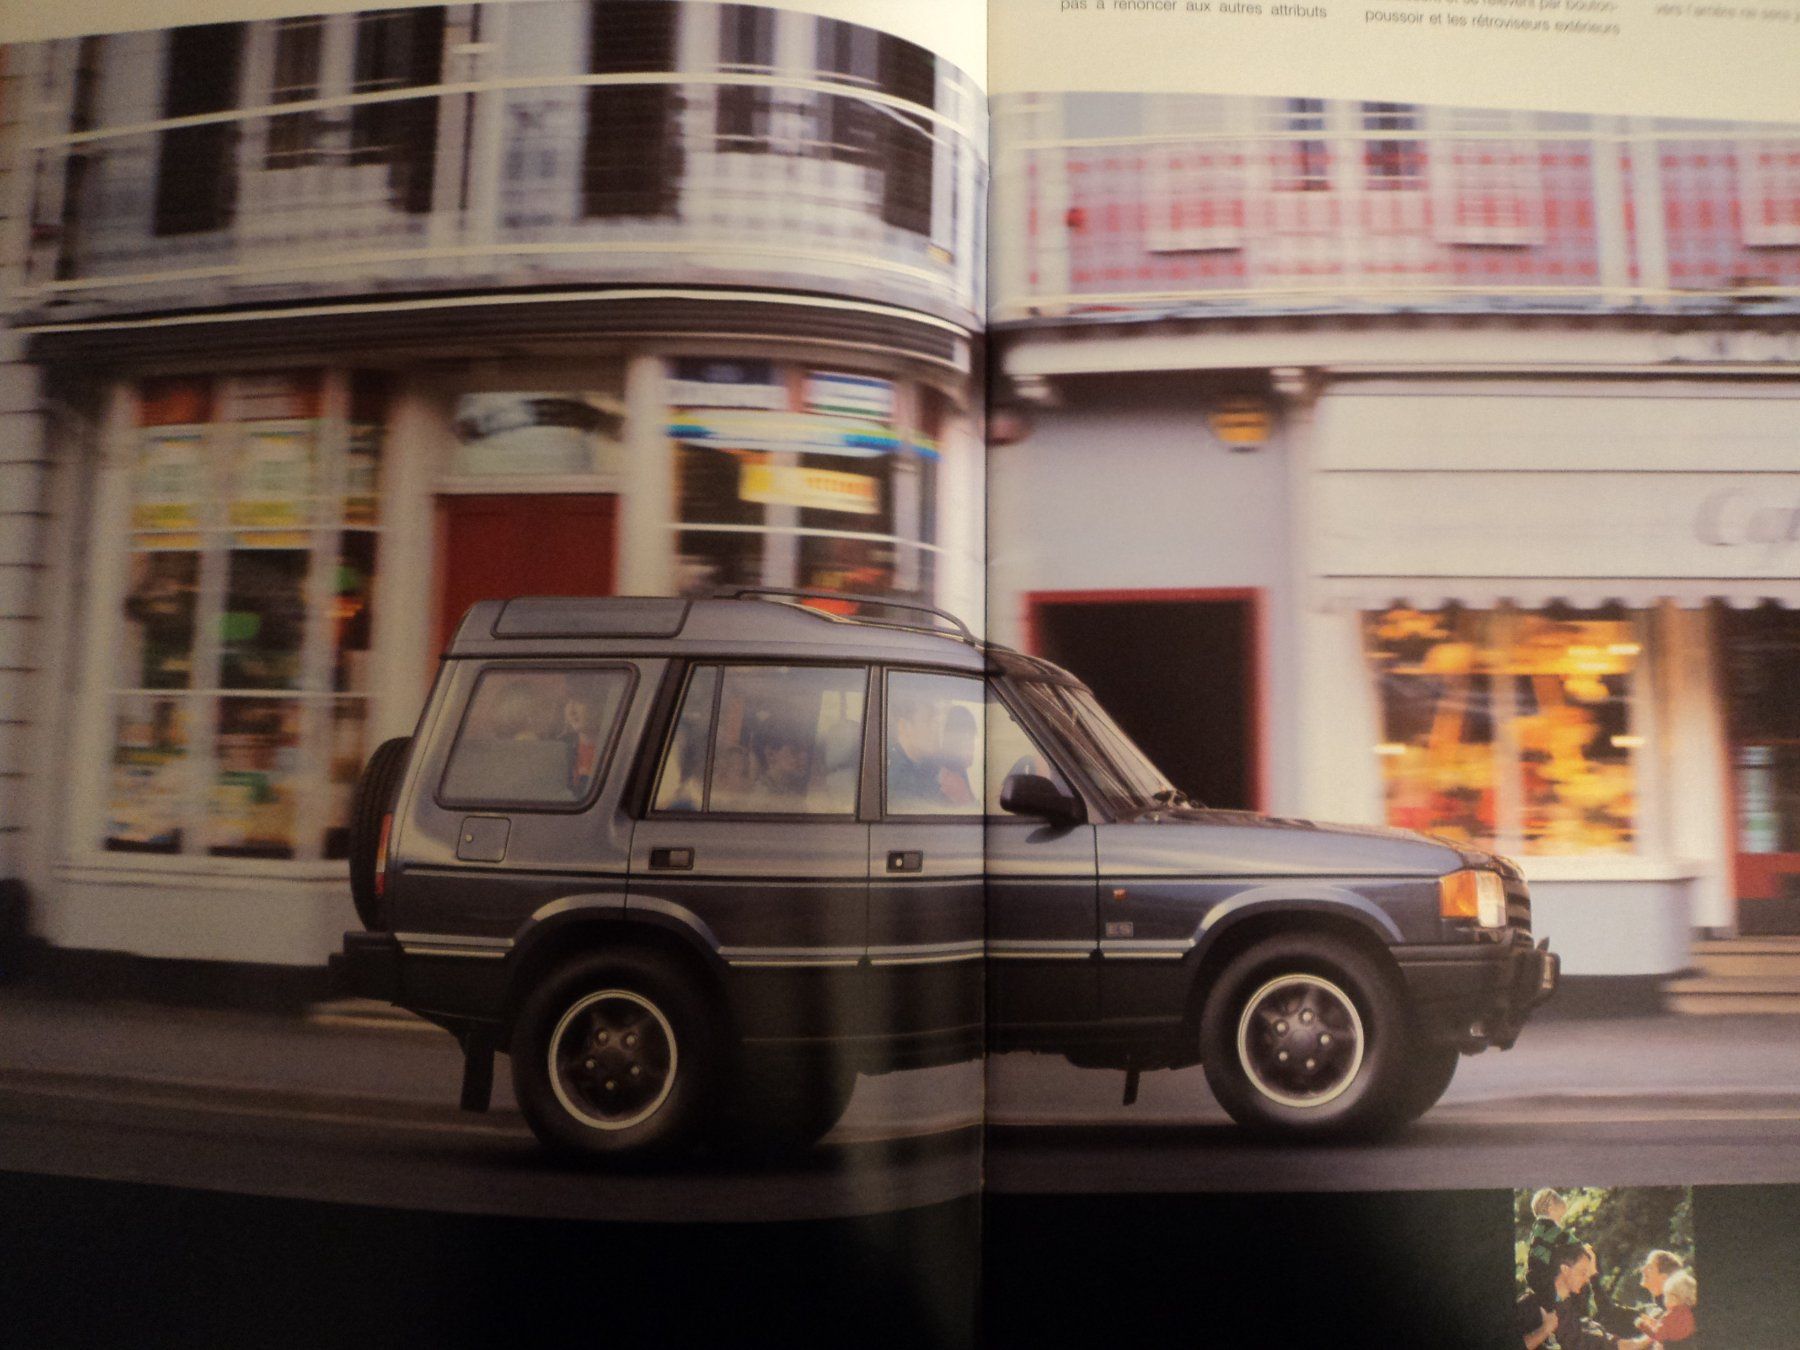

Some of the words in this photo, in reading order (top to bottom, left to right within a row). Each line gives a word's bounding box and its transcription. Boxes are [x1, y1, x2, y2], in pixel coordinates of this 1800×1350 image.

[1061, 0, 1087, 12] pas
[1113, 0, 1176, 11] renoncer
[1186, 0, 1211, 12] aux
[1219, 1, 1262, 15] autres
[1271, 4, 1328, 18] attributs
[1365, 9, 1423, 24] poussoir
[1429, 12, 1441, 24] et
[1447, 12, 1467, 27] les
[1472, 13, 1550, 31] rétroviseurs
[1554, 19, 1621, 35] extérieurs
